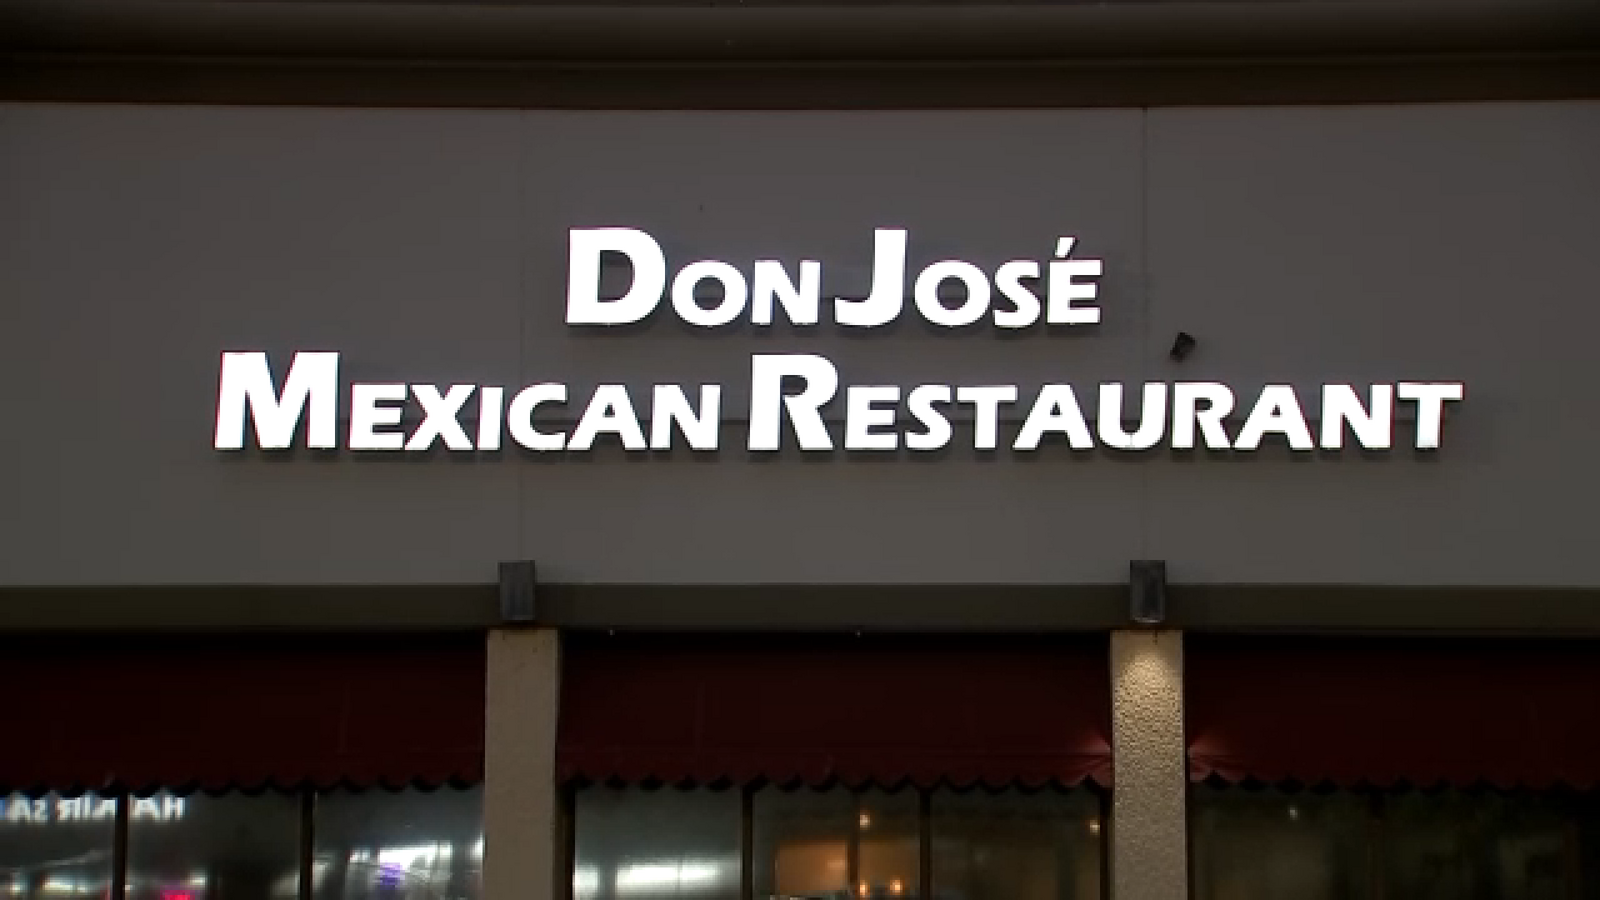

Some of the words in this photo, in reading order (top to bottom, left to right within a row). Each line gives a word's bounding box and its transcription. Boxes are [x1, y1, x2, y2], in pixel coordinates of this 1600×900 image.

[566, 227, 822, 326] DON
[834, 228, 1102, 327] JOSÉ
[214, 351, 721, 451] MEXICAN
[748, 353, 1463, 451] RESTAURANT
